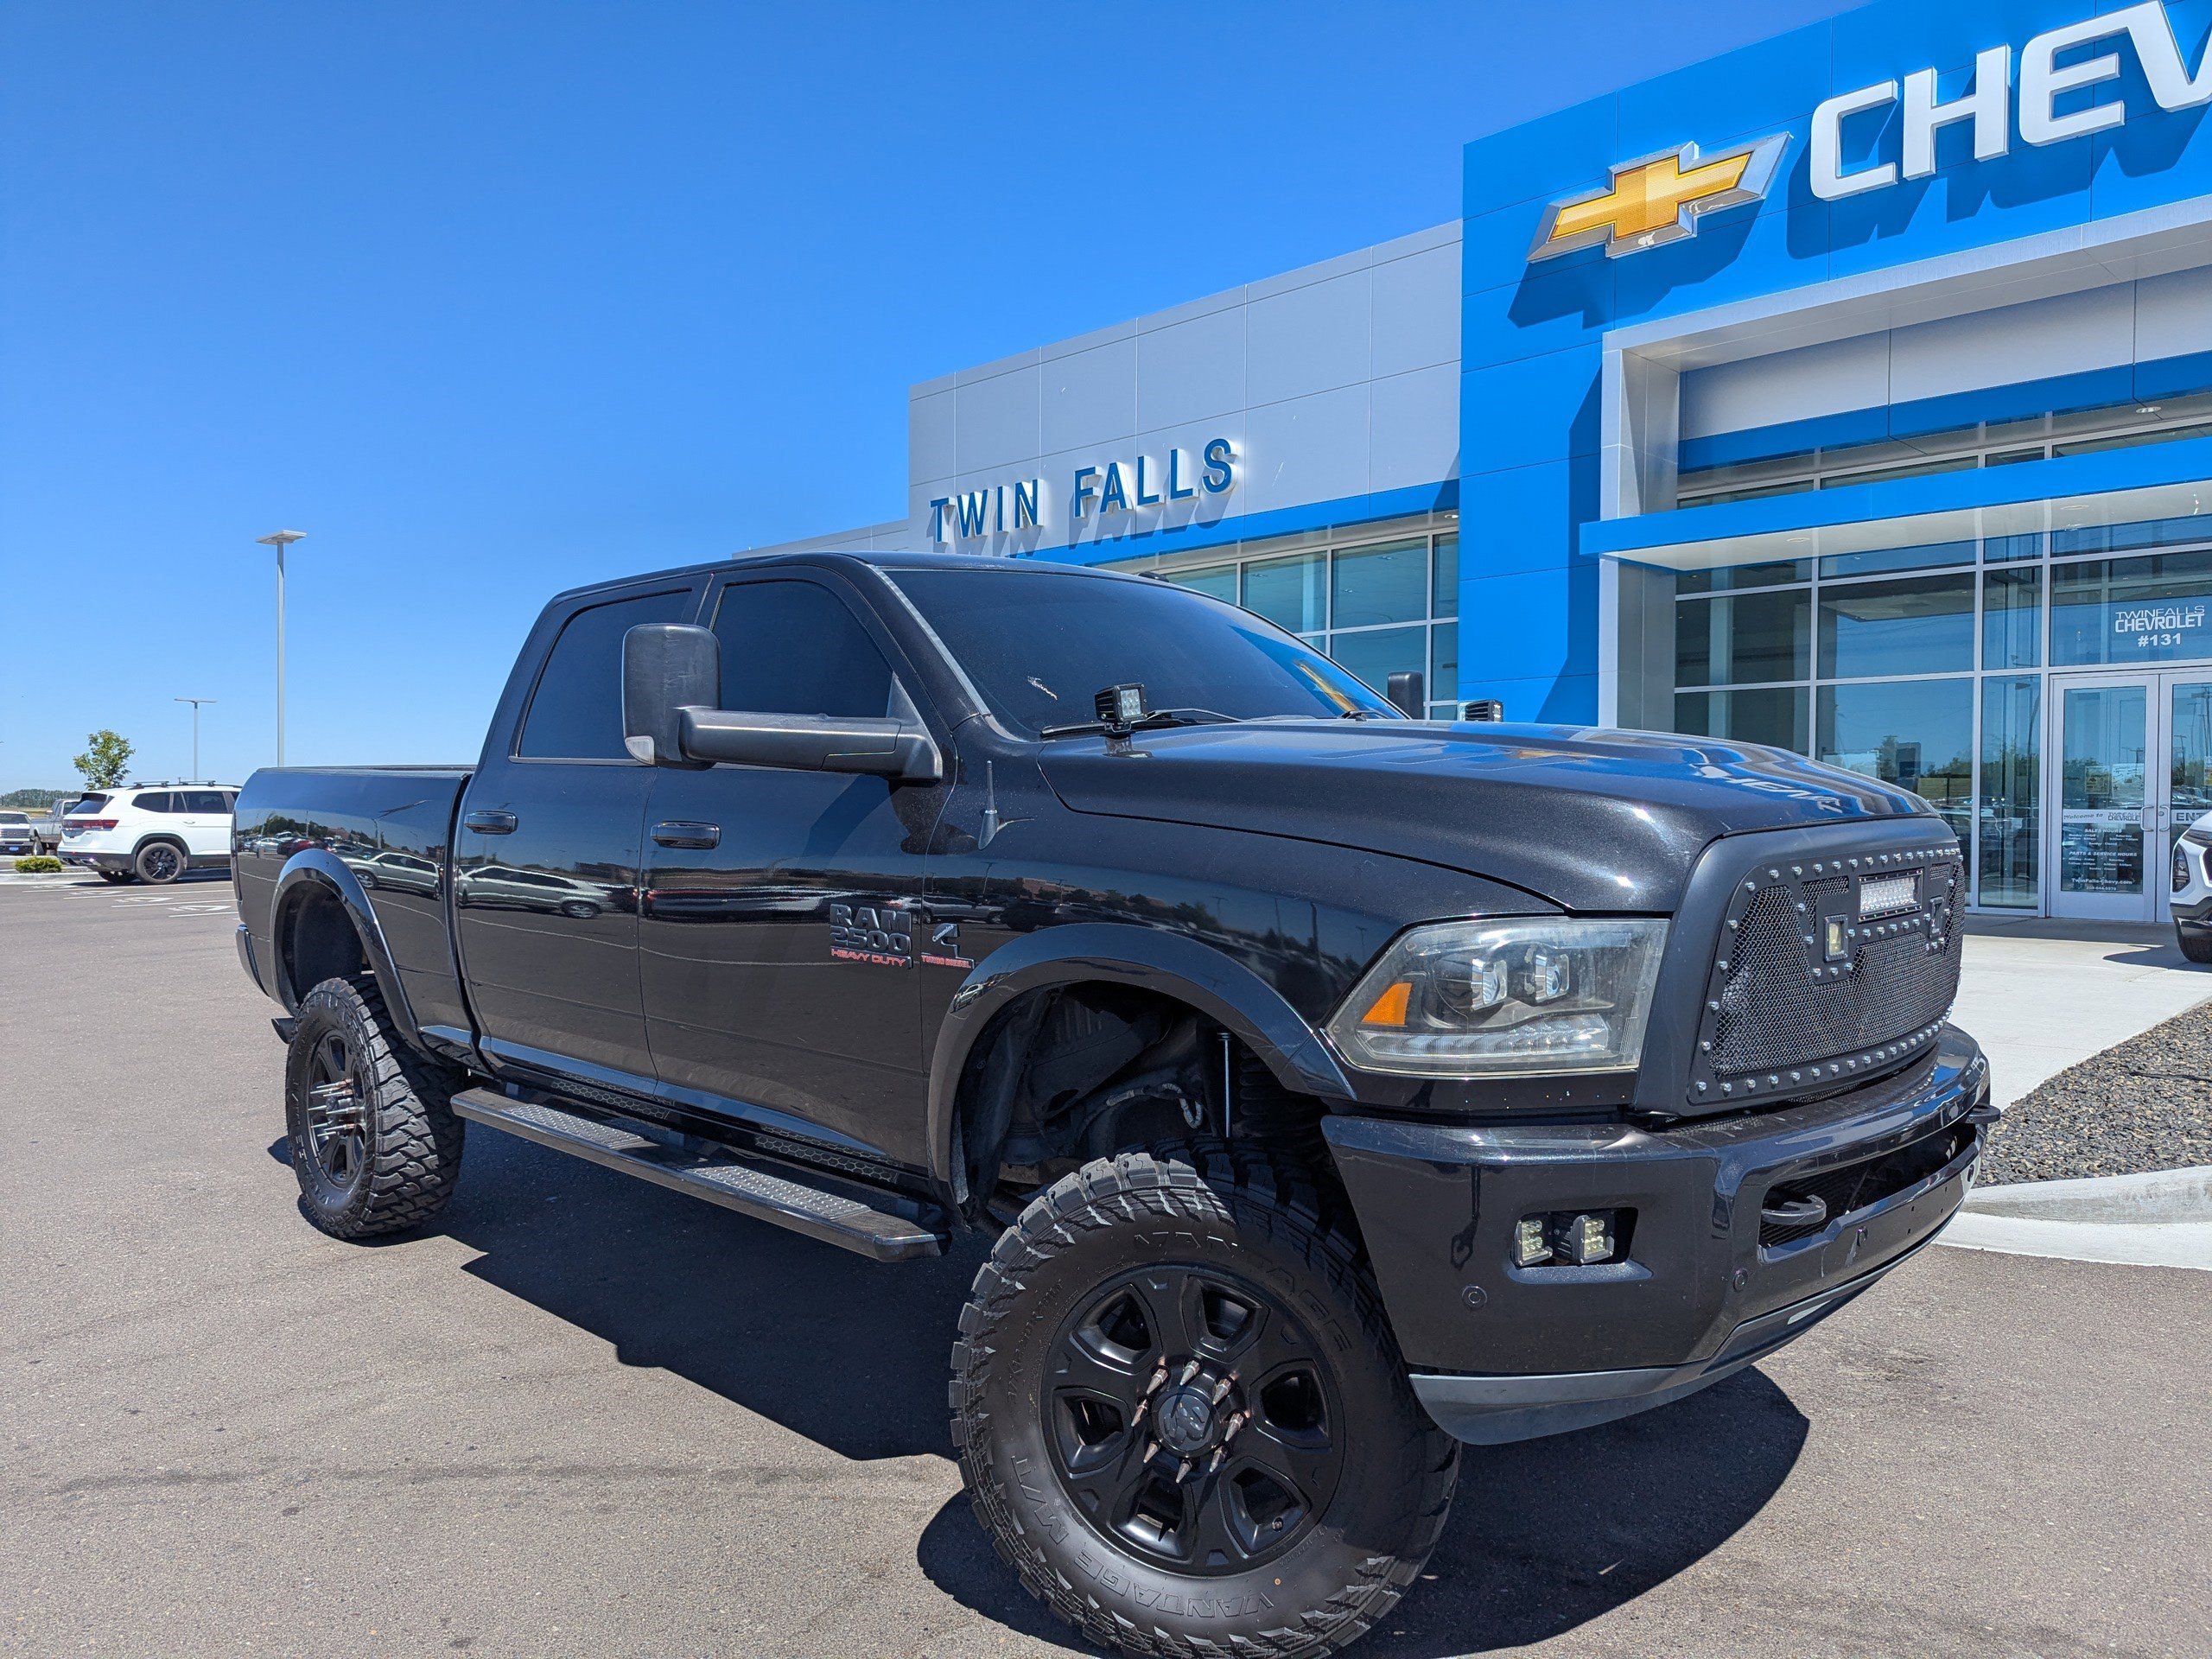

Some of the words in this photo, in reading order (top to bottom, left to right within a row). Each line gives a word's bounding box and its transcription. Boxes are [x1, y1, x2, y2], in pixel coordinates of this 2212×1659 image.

[1810, 0, 2212, 202] CHEV
[930, 479, 1042, 543] TWIN
[1074, 438, 1237, 518] FALLS
[2115, 613, 2205, 632] CHEVROLET
[2138, 632, 2181, 647] #131
[830, 903, 912, 933] RAM
[830, 925, 912, 954] 2500
[831, 948, 871, 963] HEAVY
[871, 954, 906, 967] DUTY
[1011, 1455, 1069, 1545] M/T
[1073, 1548, 1274, 1618] VANTAGE
